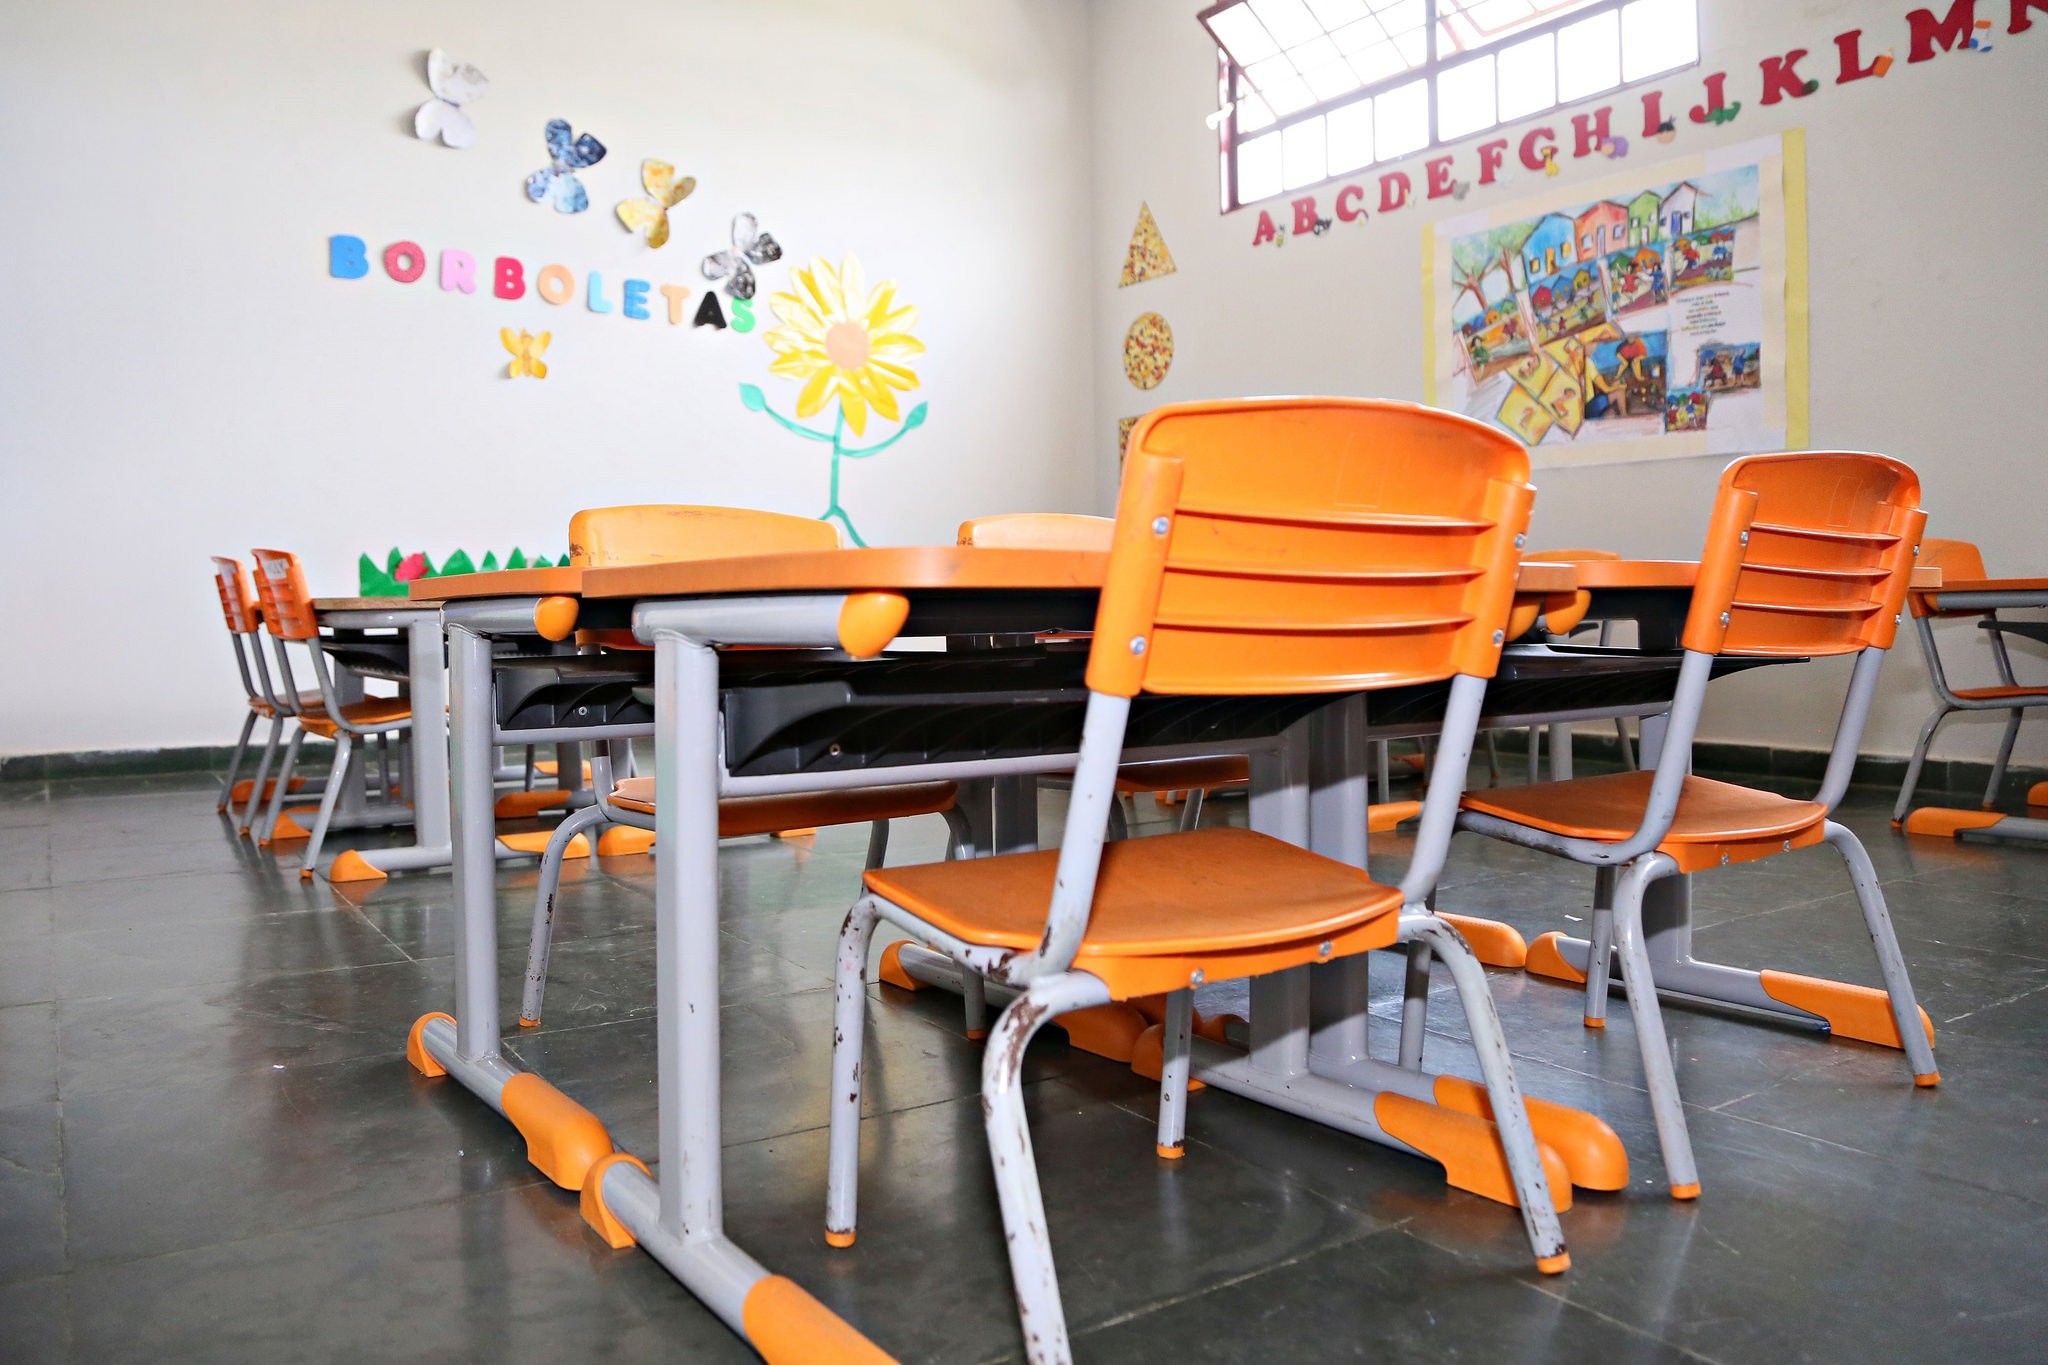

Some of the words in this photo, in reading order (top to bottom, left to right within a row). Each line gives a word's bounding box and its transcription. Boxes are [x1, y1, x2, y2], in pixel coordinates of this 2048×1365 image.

[1252, 210, 1275, 246] A
[1291, 196, 1319, 236] B
[1336, 185, 1369, 222] C
[1378, 171, 1411, 213] D
[1425, 155, 1457, 200] E
[1477, 138, 1508, 185] F
[1519, 127, 1559, 171] G
[1571, 106, 1612, 158] H
[1641, 90, 1663, 138] I
[1689, 71, 1727, 124] J
[1760, 48, 1819, 106] K
[1834, 29, 1881, 84] L
[1905, 0, 1975, 64] M
[329, 234, 756, 333] BORBOLETAS
